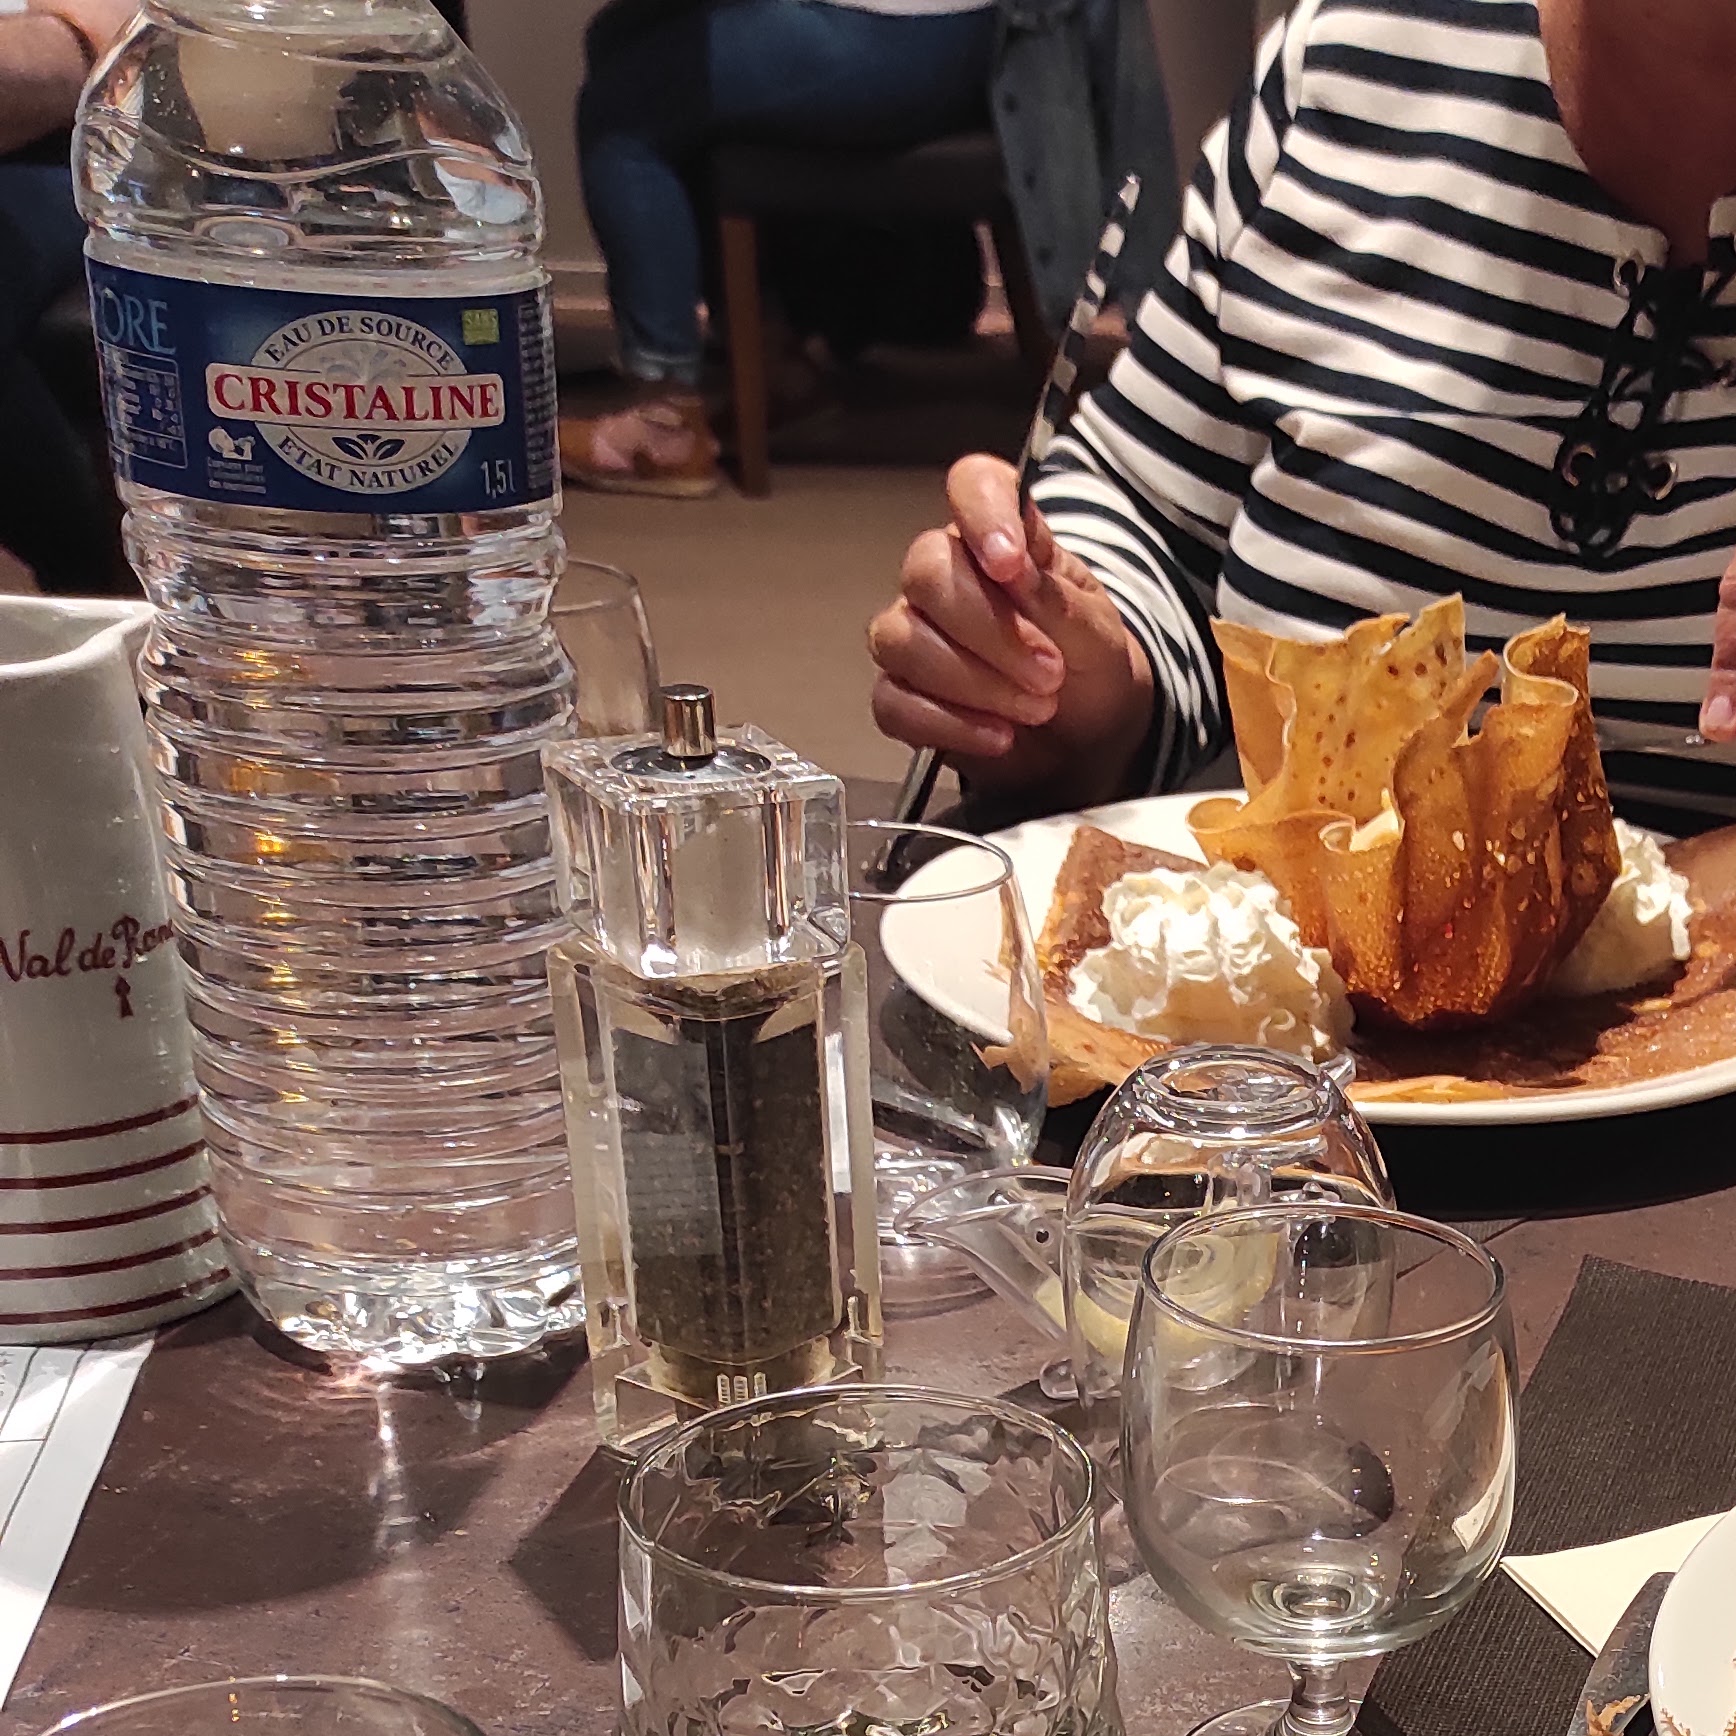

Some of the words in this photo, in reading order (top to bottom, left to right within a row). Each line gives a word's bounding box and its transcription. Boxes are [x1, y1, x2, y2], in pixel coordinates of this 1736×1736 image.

[264, 323, 312, 364] EAU
[319, 315, 353, 336] DE
[361, 316, 454, 369] SOURCE
[213, 372, 500, 422] CRISTALINE
[278, 435, 342, 485] ETAT
[350, 442, 458, 489] NATUREL
[0, 927, 76, 982] Val
[79, 933, 116, 972] de
